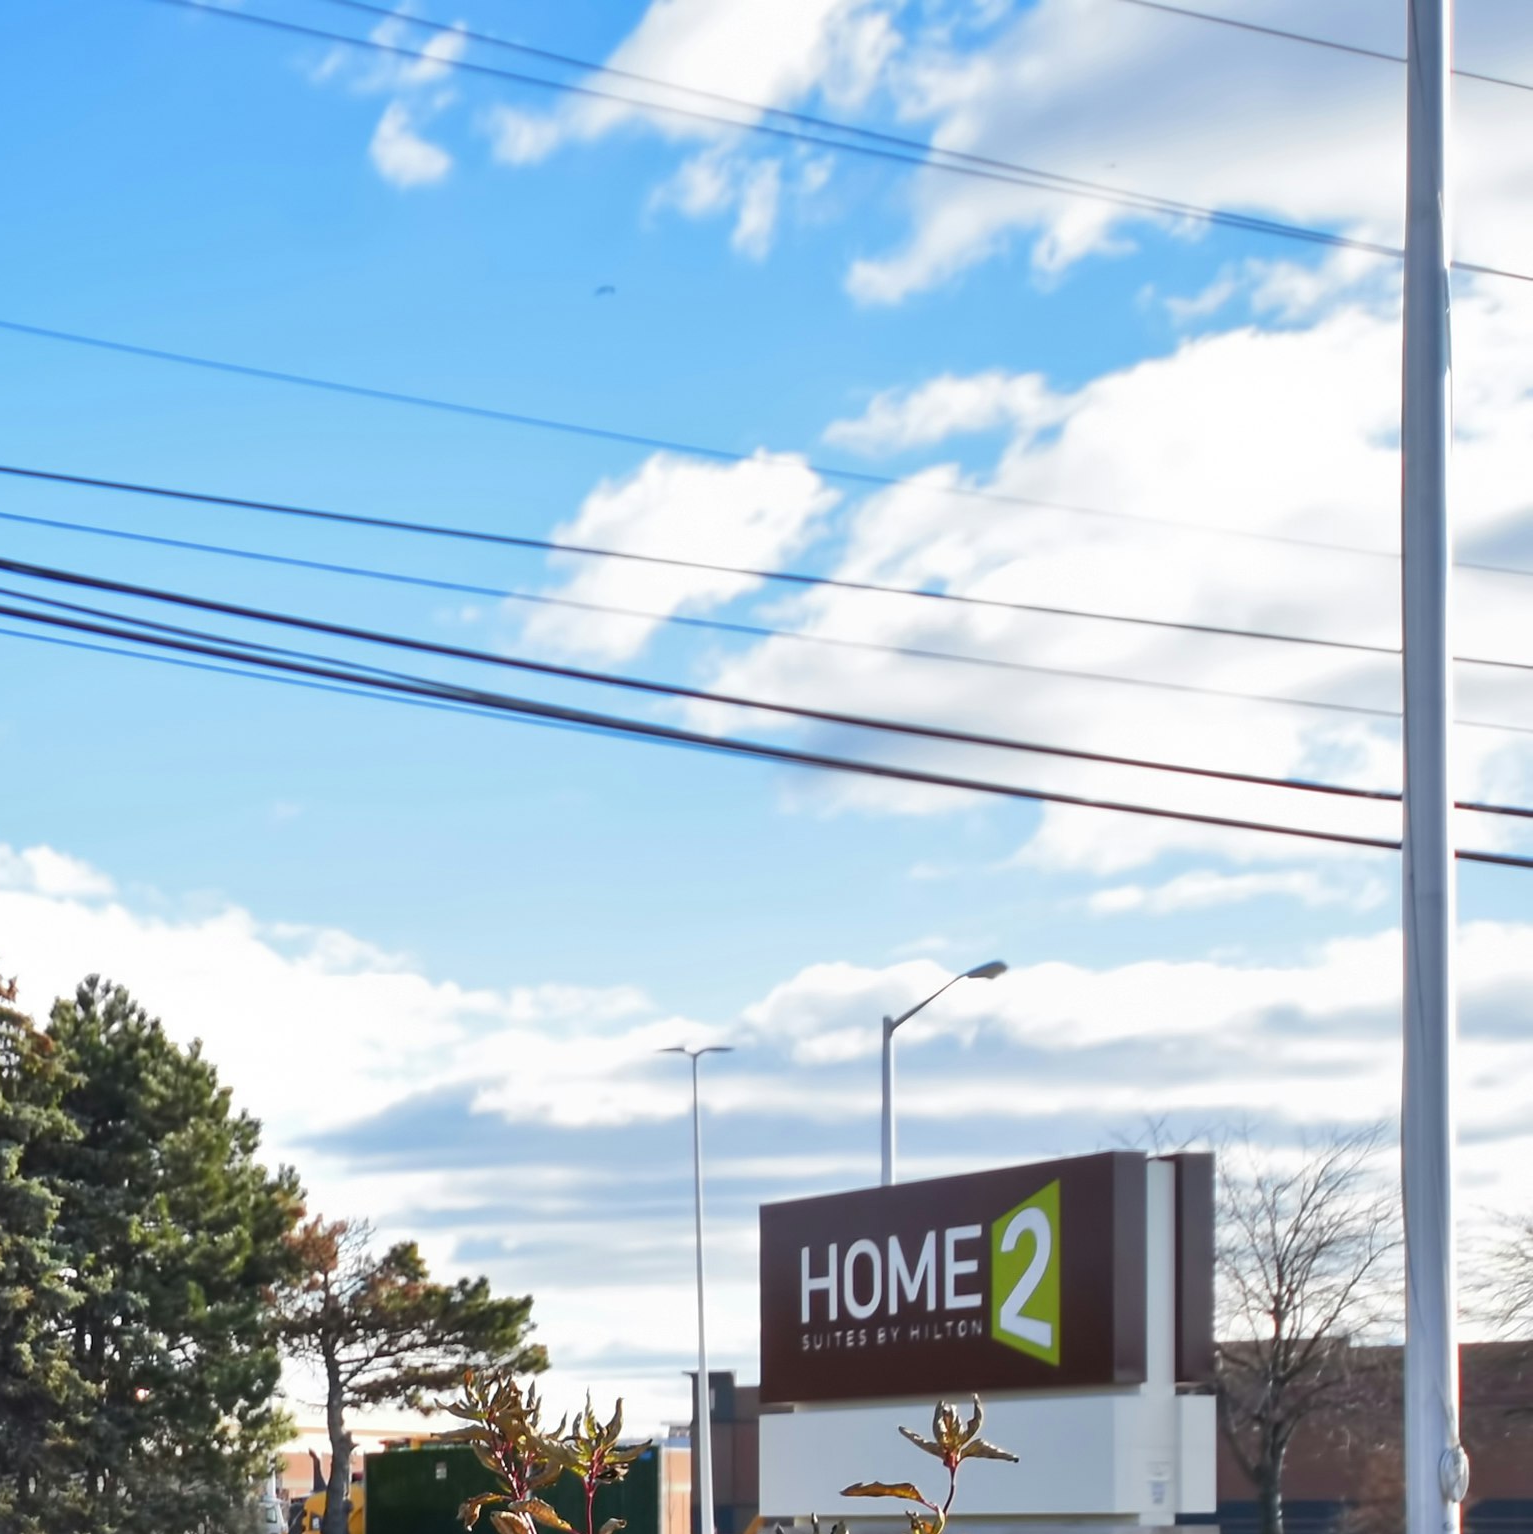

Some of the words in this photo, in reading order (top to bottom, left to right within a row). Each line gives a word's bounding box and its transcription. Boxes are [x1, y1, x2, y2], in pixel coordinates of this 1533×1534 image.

[801, 1328, 867, 1351] SUITES
[876, 1325, 900, 1345] BY
[909, 1319, 983, 1342] HILTON
